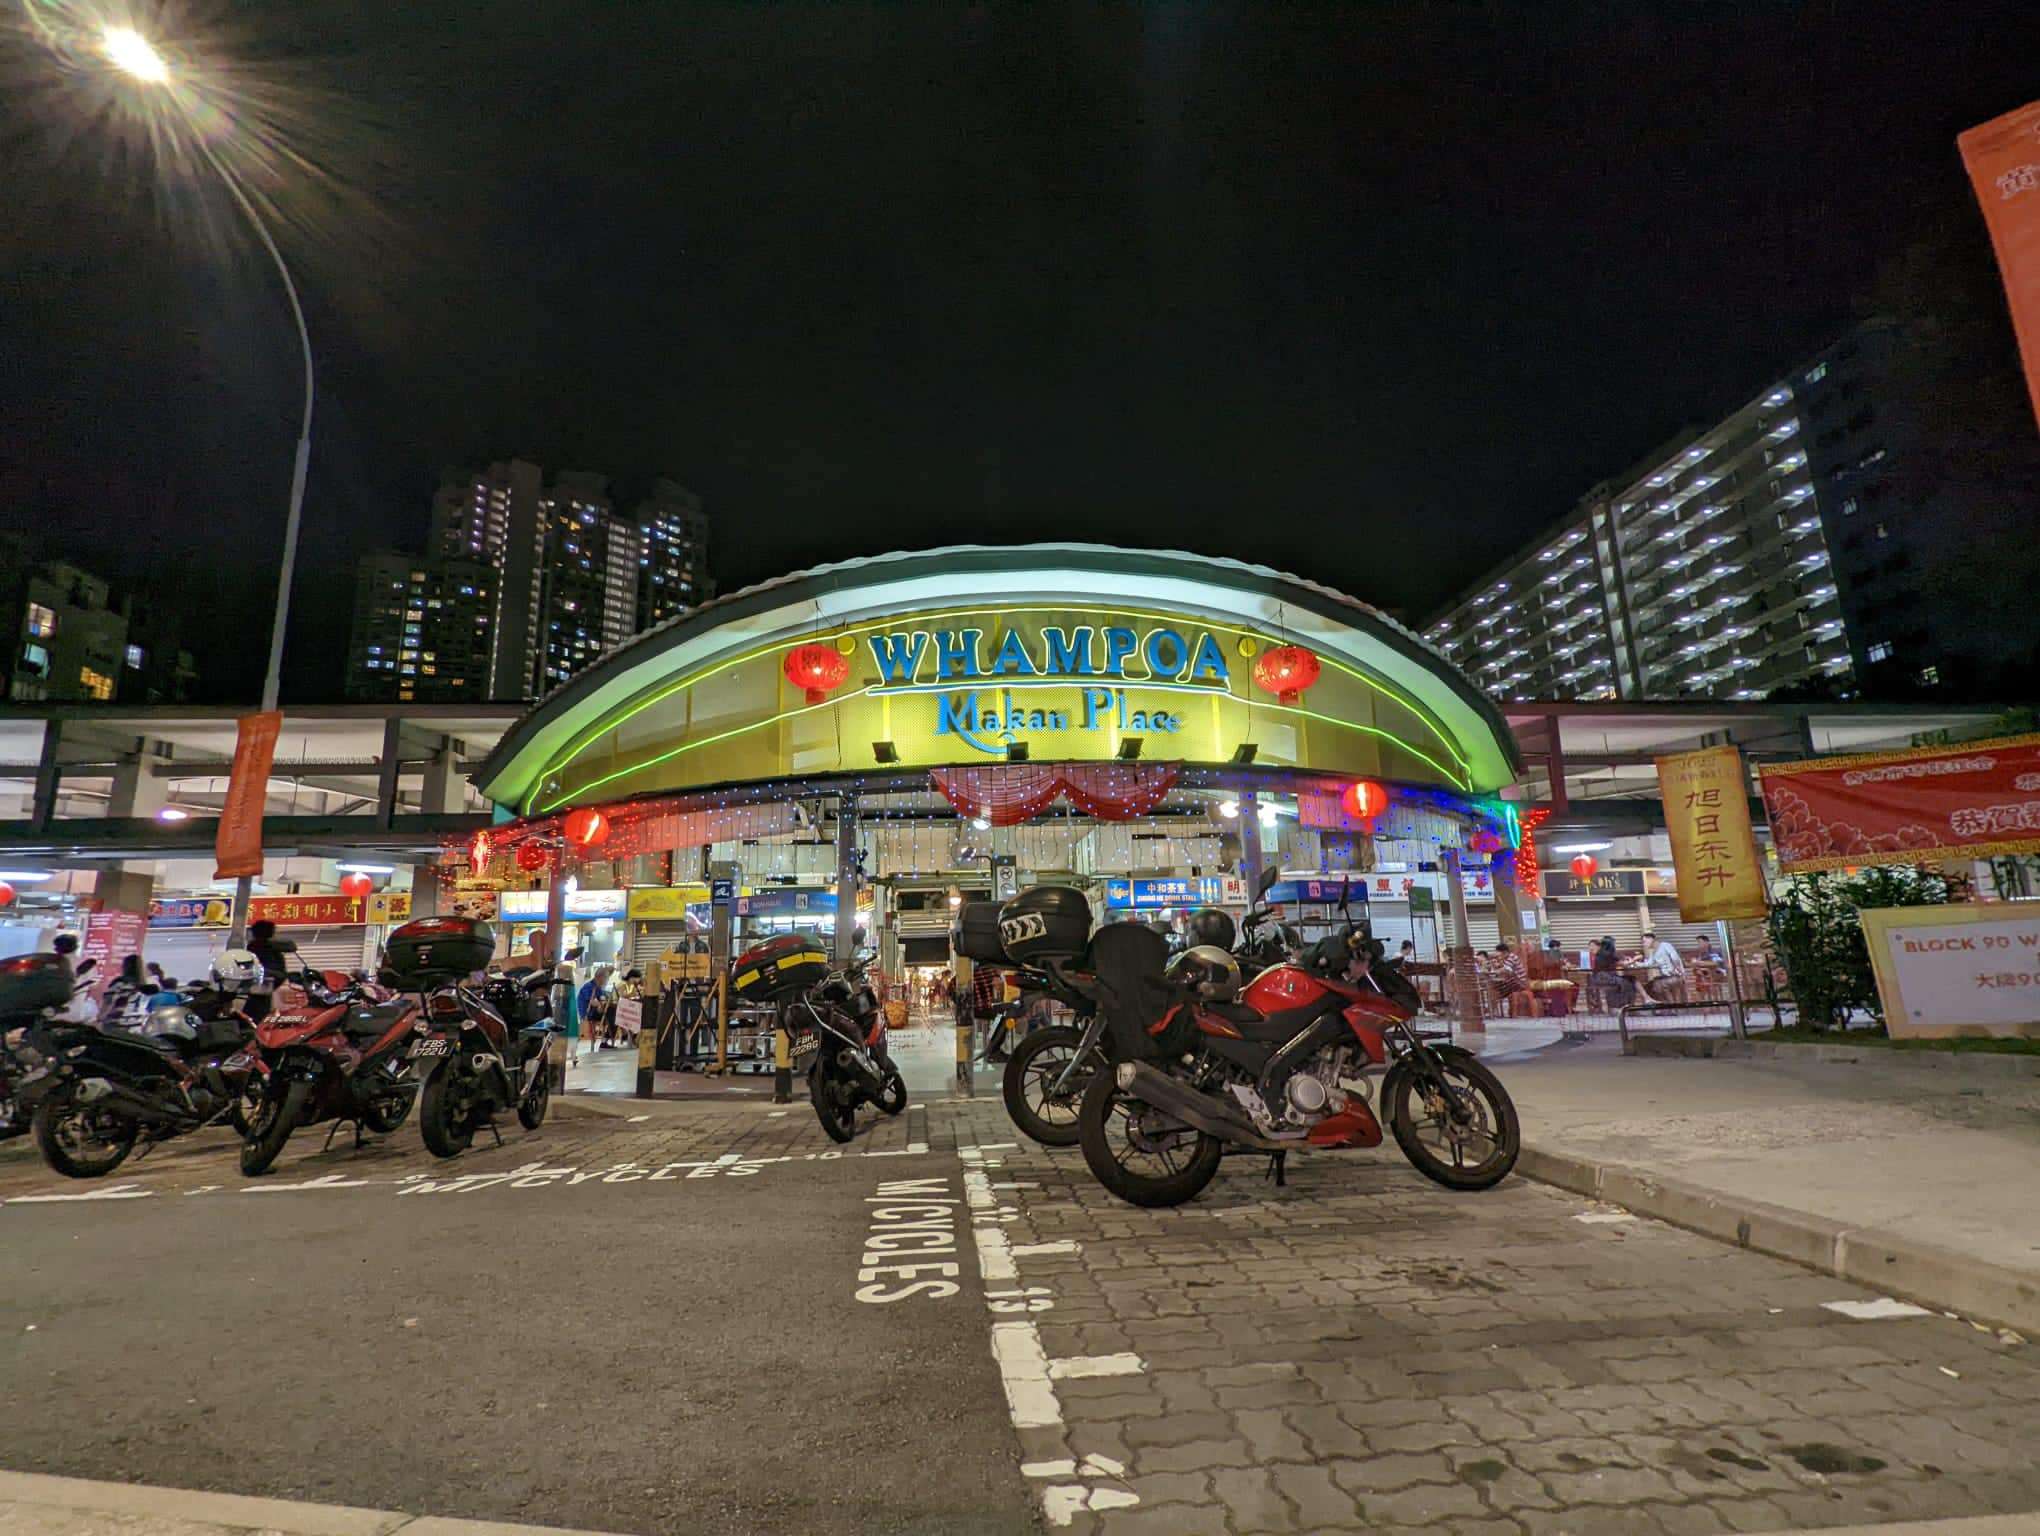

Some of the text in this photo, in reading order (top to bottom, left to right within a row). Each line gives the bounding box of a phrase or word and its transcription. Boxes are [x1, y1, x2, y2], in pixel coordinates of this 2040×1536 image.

[868, 626, 1230, 684] WHAMPOA
[935, 688, 1181, 753] Makan Place
[1684, 788, 1736, 889] 旭日东升
[1904, 937, 1977, 953] BLOCK
[1982, 935, 2011, 949] 90
[396, 1162, 766, 1195] M/CYCLES
[855, 1177, 961, 1304] M/CYCLES
